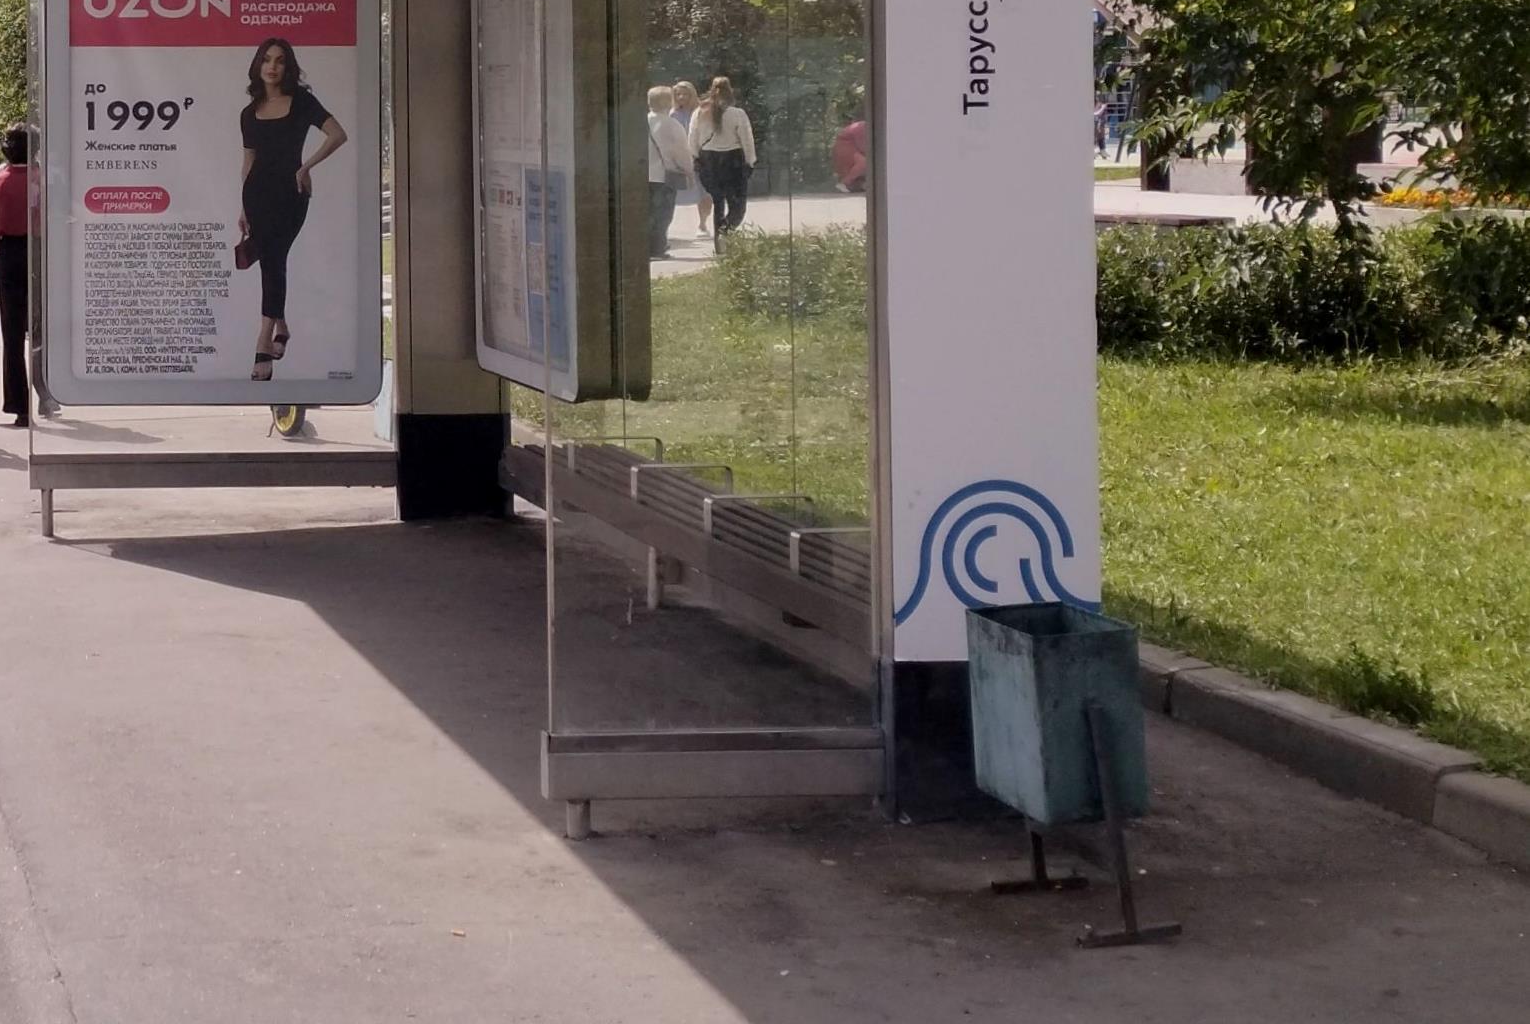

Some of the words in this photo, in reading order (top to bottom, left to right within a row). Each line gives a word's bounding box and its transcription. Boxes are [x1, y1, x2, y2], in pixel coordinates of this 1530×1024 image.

[240, 2, 336, 13] РАСПРОДАЖА
[240, 15, 303, 25] ОДЕЖДЫ
[84, 141, 136, 151] Женские
[139, 143, 178, 152] платья
[86, 160, 158, 170] EMBERENS
[91, 191, 130, 200] ОПЛАТА
[130, 191, 164, 200] ПОСЛЕ
[102, 202, 153, 211] ПРИМЕРКИ
